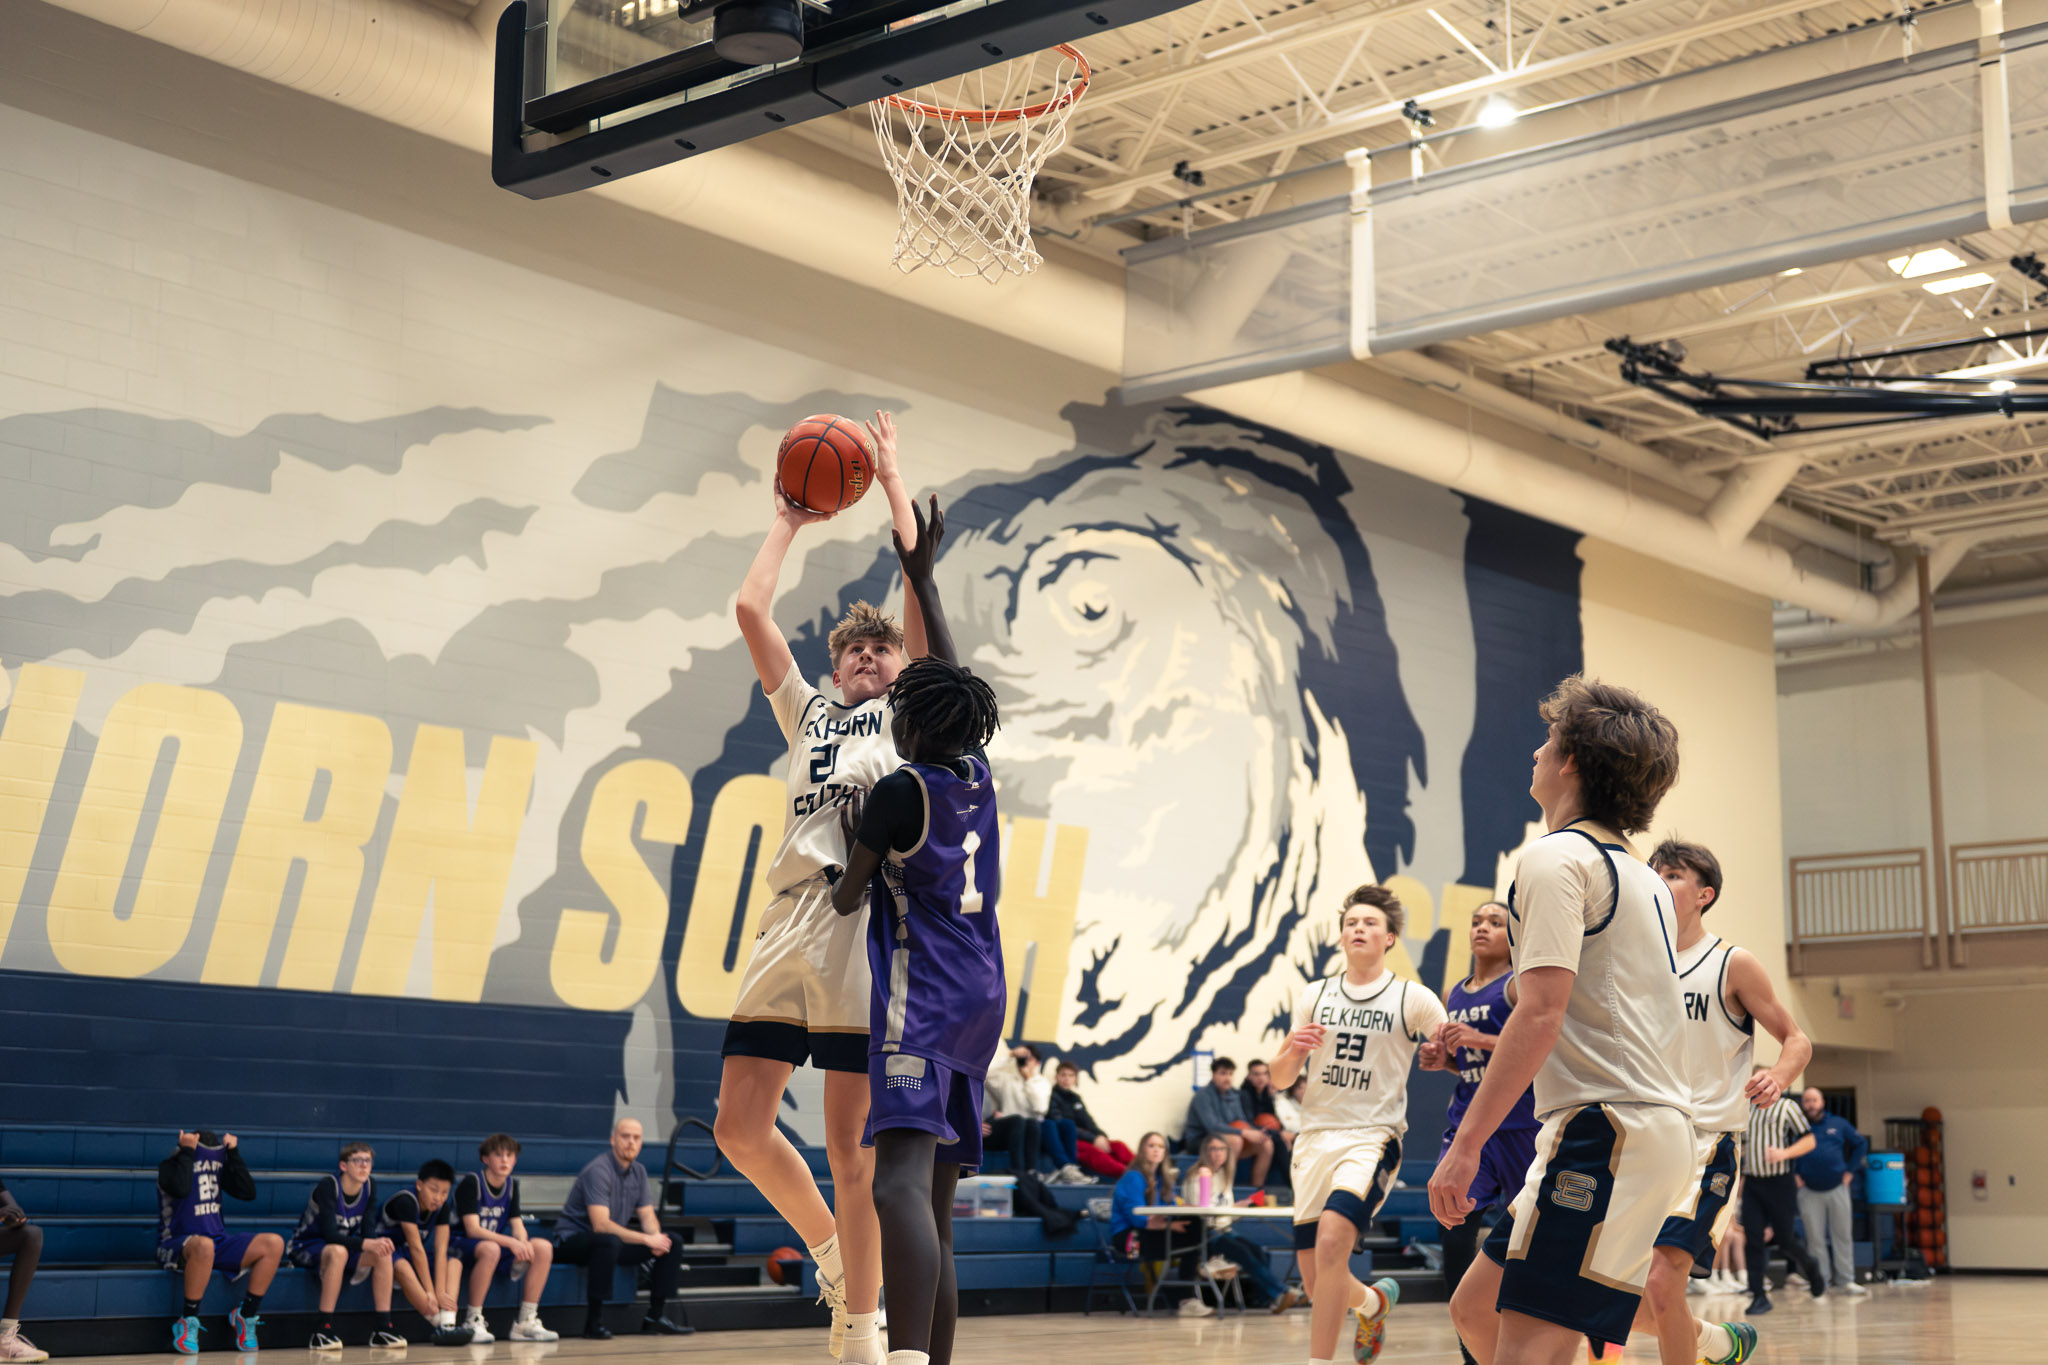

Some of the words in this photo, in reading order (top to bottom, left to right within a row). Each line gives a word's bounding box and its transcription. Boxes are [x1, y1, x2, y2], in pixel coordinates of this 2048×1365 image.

[805, 710, 883, 740] KHORN
[810, 743, 841, 784] 21
[960, 830, 984, 915] 1
[550, 759, 1090, 1043] SOH
[1320, 1006, 1395, 1034] ELKHORN
[1448, 1005, 1491, 1023] EAST
[1335, 1032, 1368, 1063] 23
[1321, 1064, 1372, 1092] SOUTH
[194, 1202, 221, 1216] HIG
